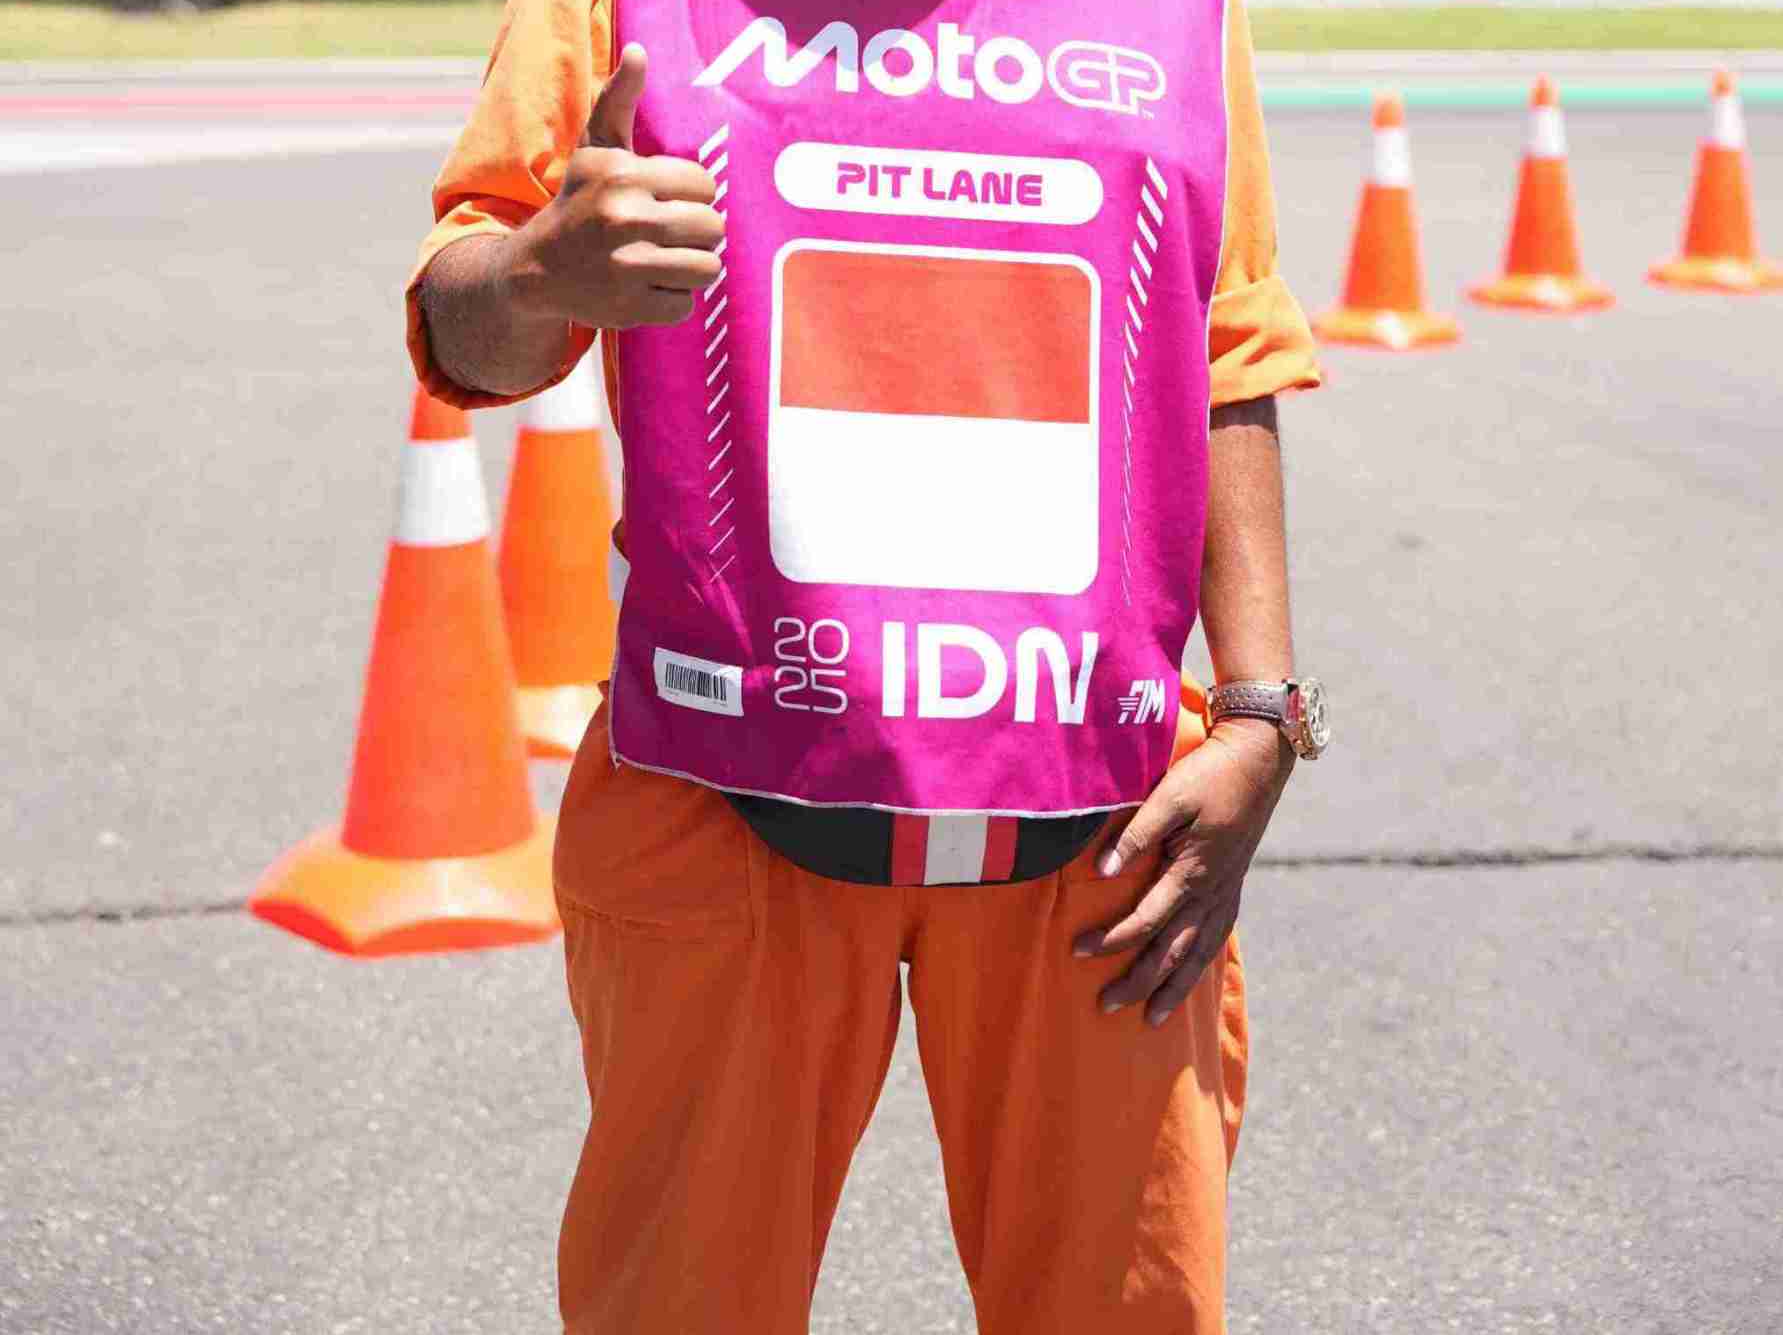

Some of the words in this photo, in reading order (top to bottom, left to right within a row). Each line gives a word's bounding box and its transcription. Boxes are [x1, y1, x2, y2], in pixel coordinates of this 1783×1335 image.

[691, 16, 1167, 115] MotoGP
[836, 162, 912, 199] PIT
[922, 168, 1043, 206] LANE
[774, 617, 850, 664] 20
[881, 621, 1099, 725] IDN
